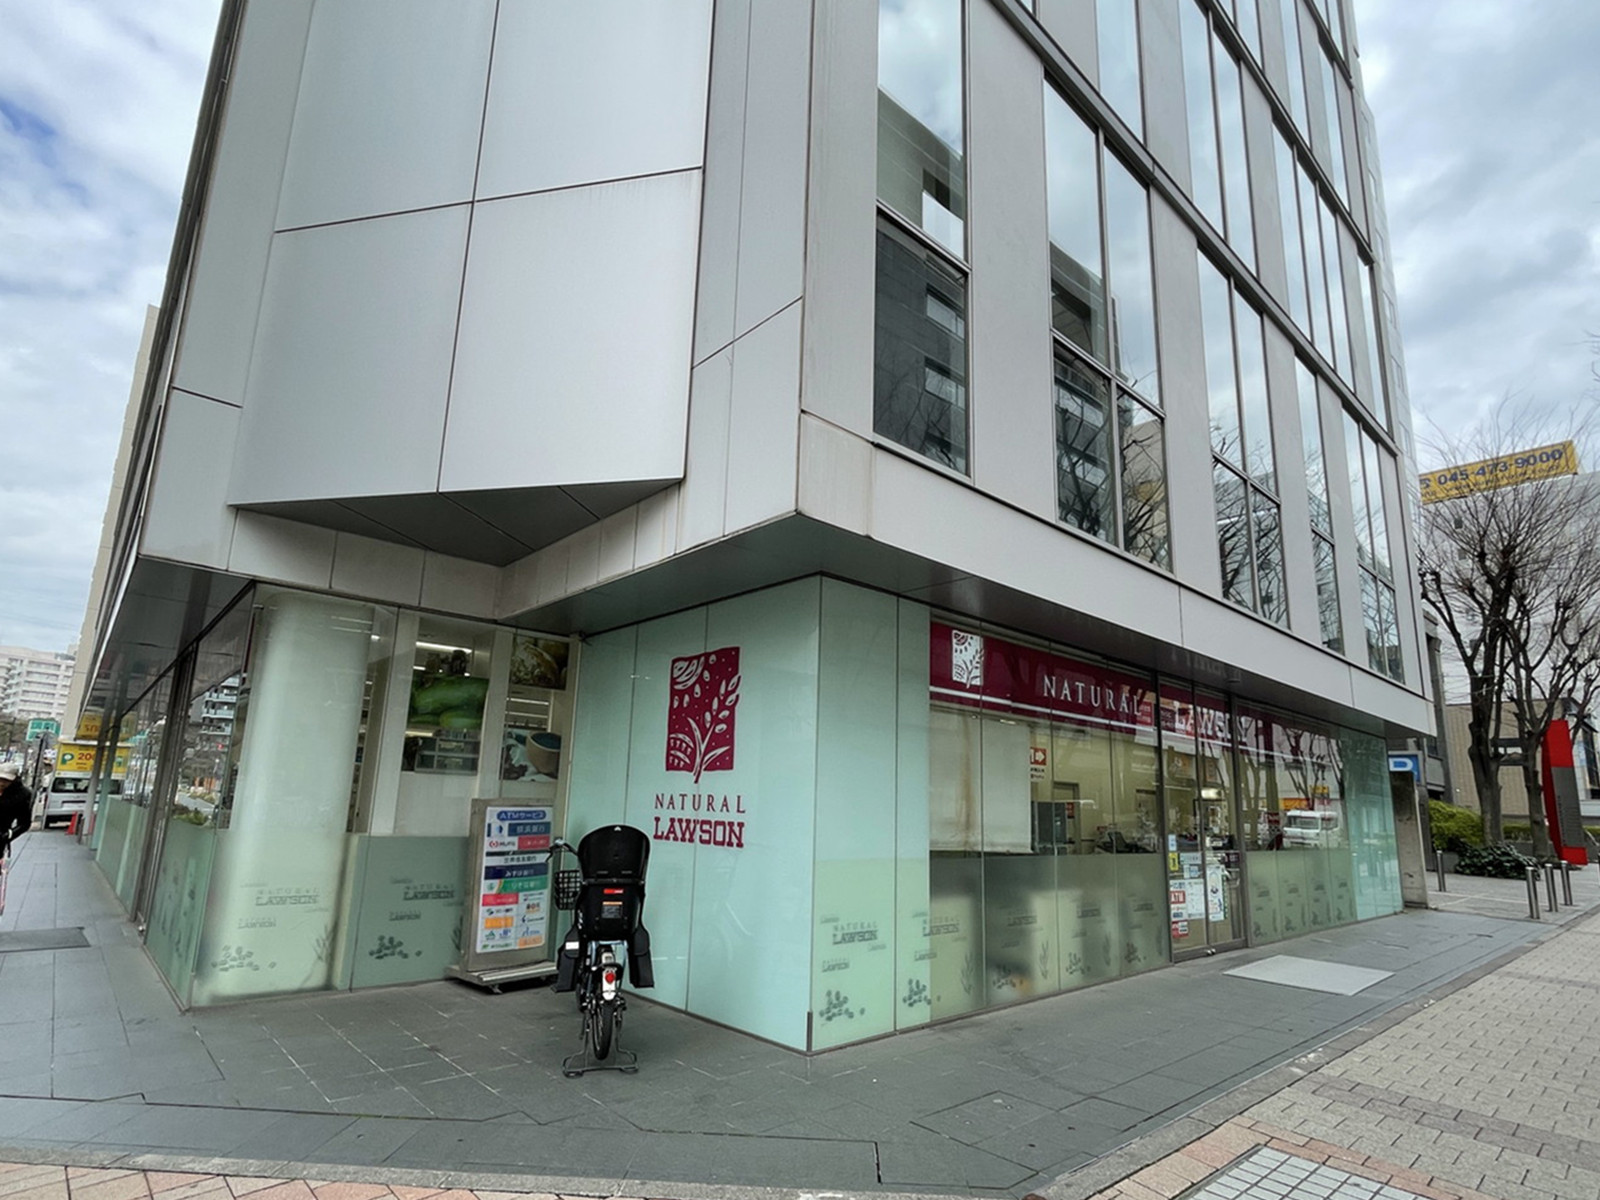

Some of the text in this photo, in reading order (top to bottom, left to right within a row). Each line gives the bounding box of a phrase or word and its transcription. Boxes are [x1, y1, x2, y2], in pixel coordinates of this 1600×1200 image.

[1043, 675, 1143, 717] NATURAL
[655, 793, 746, 814] NATURAL
[500, 812, 544, 820] ATMサービス
[653, 816, 745, 849] LAWSON
[255, 895, 320, 906] LAWSON
[403, 890, 455, 901] LAWSON
[832, 929, 879, 946] LAWSON
